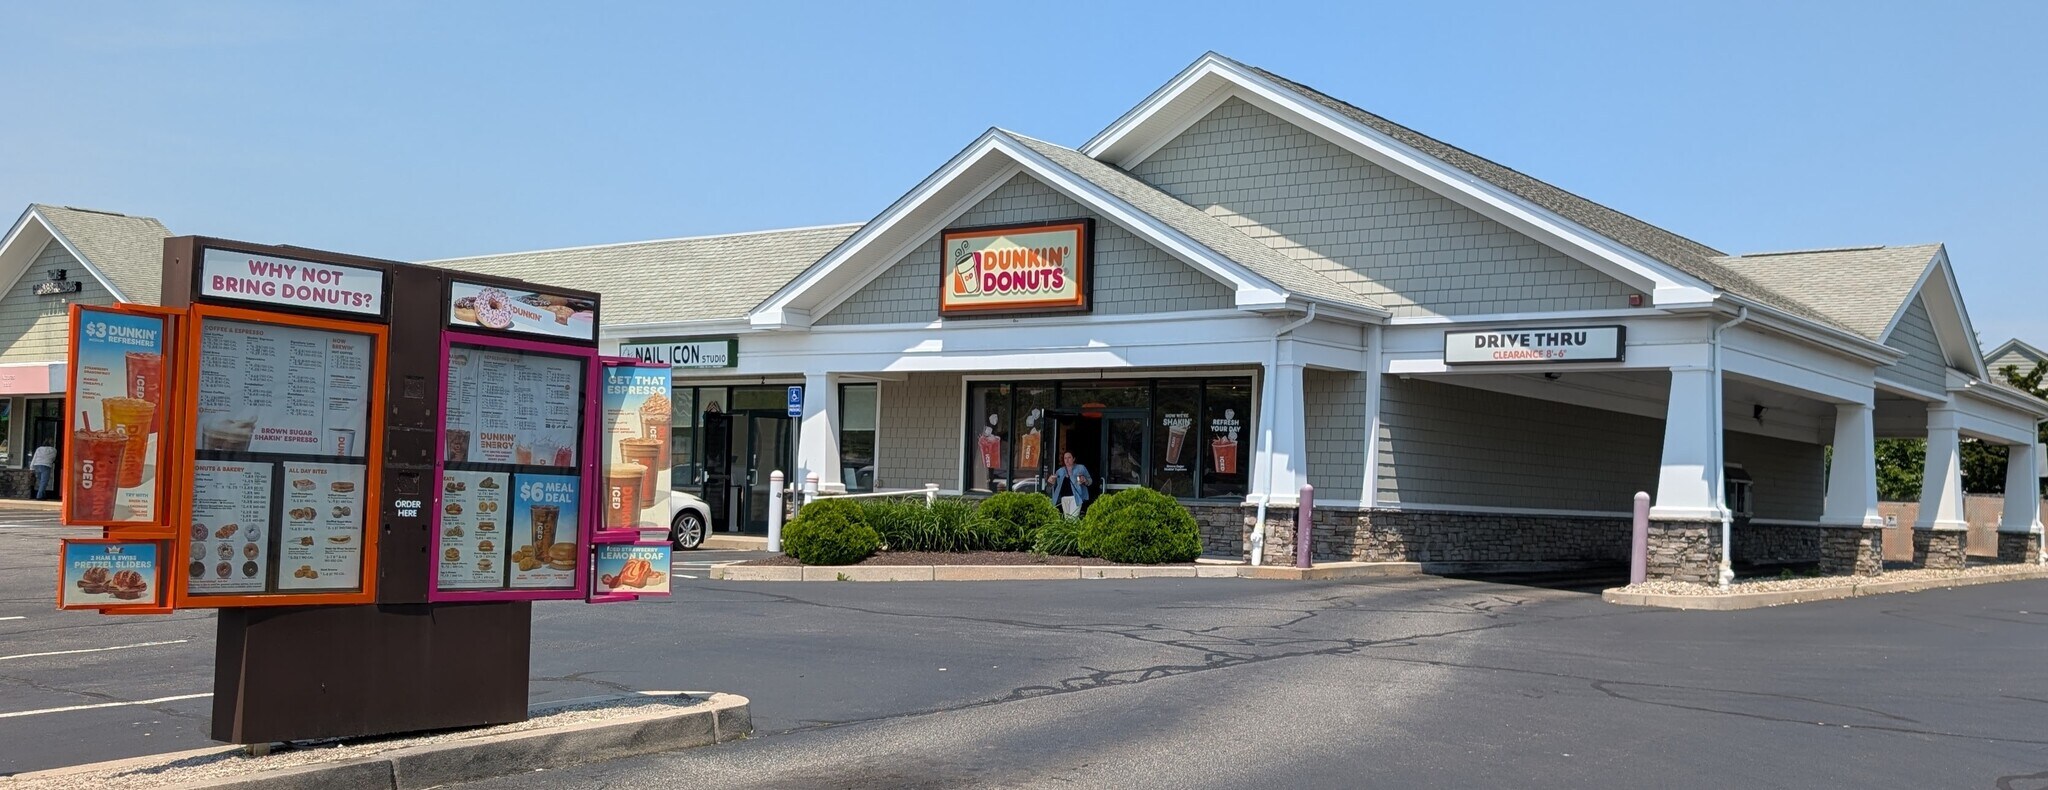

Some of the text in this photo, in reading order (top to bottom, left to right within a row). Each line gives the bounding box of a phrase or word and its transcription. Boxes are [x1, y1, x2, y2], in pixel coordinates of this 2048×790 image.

[984, 246, 1069, 270] DUNKIN'
[248, 259, 343, 285] WHY NOT
[983, 268, 1064, 292] DONUTS
[212, 275, 373, 308] BRING DONUTS?
[512, 306, 542, 321] DUNKIN'
[86, 322, 107, 338] $3
[108, 325, 157, 340] DUNKIN'
[204, 325, 228, 333] COFFEE
[108, 336, 155, 347] REFRESHERS
[1475, 332, 1587, 348] DRIVE THRU
[636, 347, 664, 364] NAIL
[670, 345, 700, 364] ICON
[702, 355, 726, 363] STUDIO
[1493, 350, 1543, 360] CLEARANCE
[608, 375, 666, 385] GET THAT
[137, 375, 145, 399] ICED
[607, 386, 667, 395] ESPRESSO
[1163, 418, 1192, 426] SHAKIN'
[261, 427, 312, 436] BROWN SUGAR
[481, 433, 516, 441] DUNKIN'
[284, 435, 318, 443] ESPRESSO
[481, 441, 514, 449] ENERGY
[82, 460, 94, 490] ICED
[520, 482, 544, 502] $6
[545, 482, 574, 493] MEAL
[545, 493, 572, 503] DEAL
[612, 486, 620, 509] ICED
[395, 500, 421, 508] ORDER
[397, 509, 417, 517] HERE
[601, 552, 664, 560] LEMON LOAF
